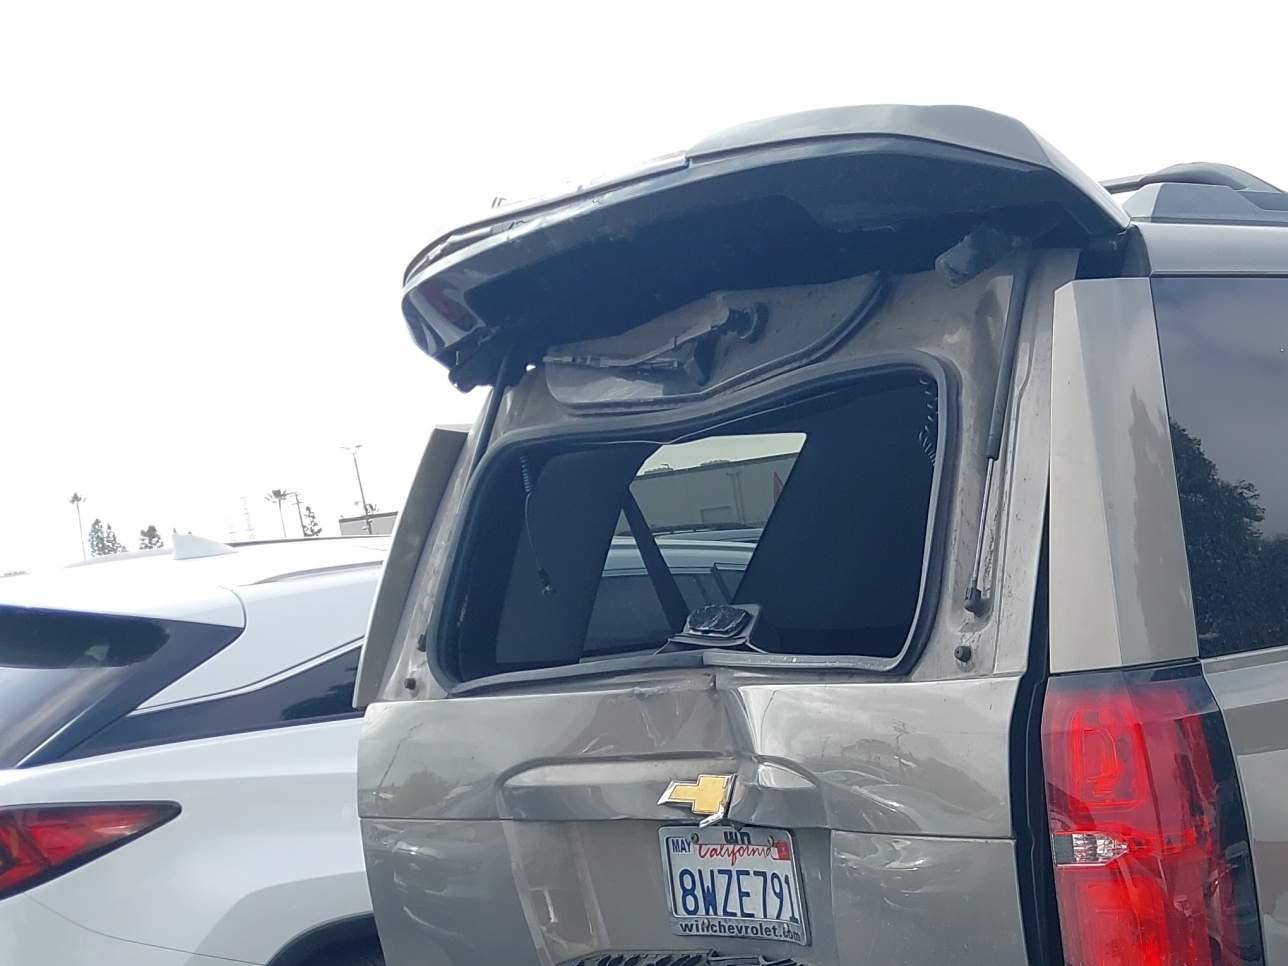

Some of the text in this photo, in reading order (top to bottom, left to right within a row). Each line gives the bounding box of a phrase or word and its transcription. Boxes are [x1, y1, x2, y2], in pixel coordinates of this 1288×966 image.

[672, 839, 691, 853] MAY
[698, 843, 772, 866] California
[679, 868, 799, 924] 8WZE791
